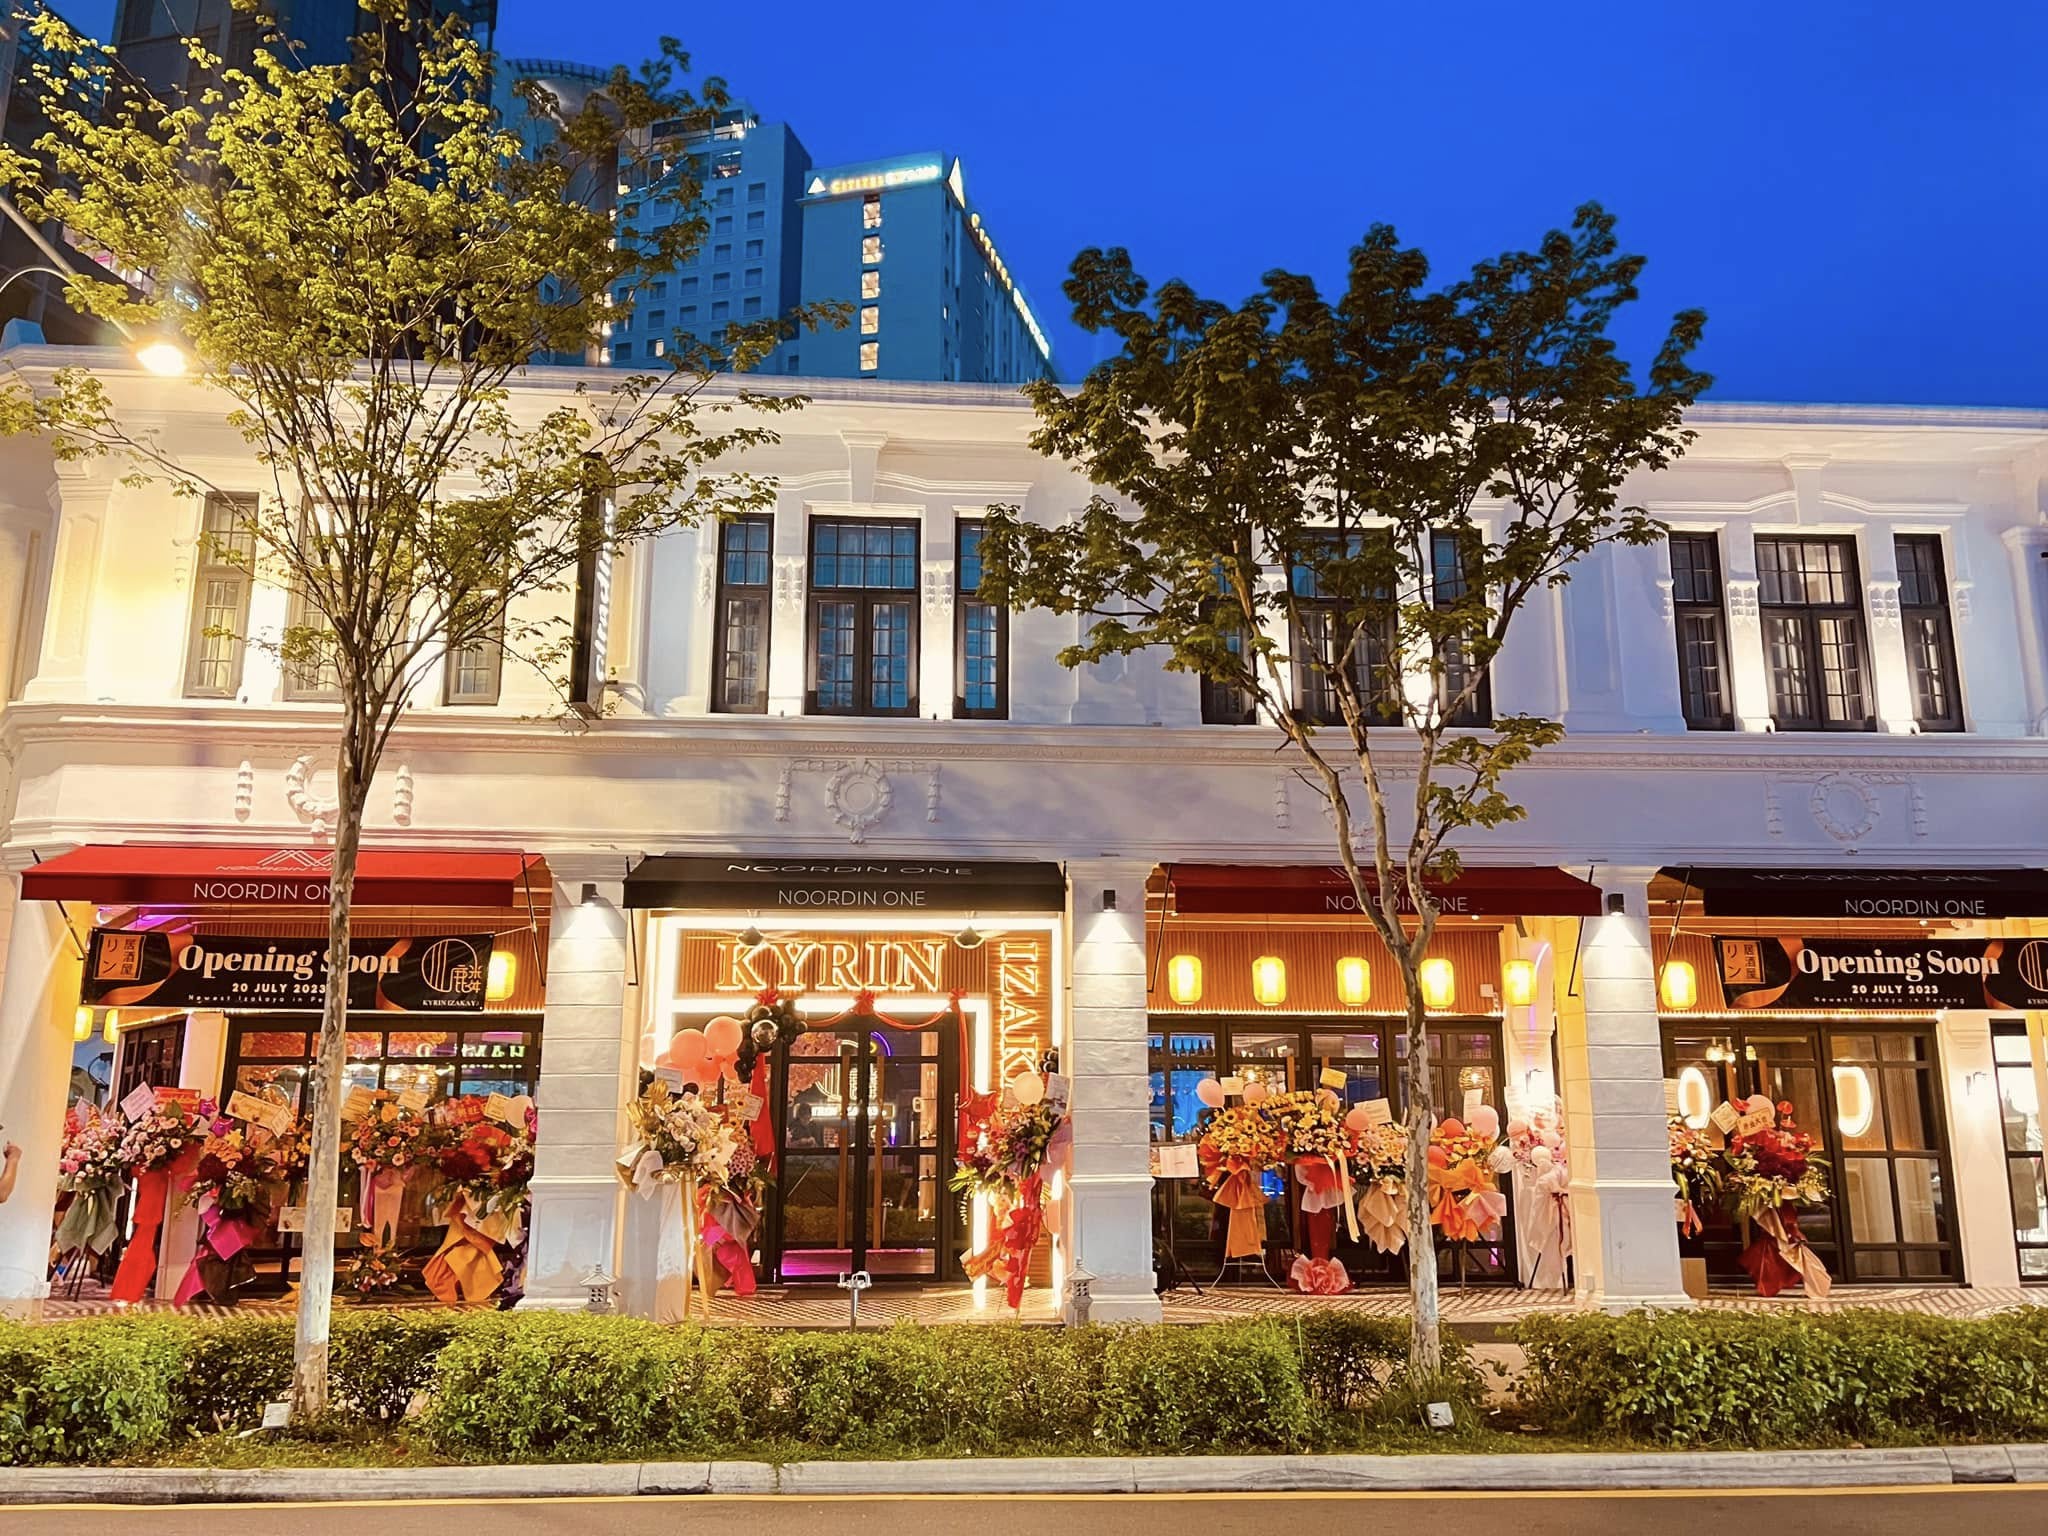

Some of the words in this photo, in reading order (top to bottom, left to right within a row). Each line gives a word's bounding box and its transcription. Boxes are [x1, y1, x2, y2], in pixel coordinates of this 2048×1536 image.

[727, 864, 888, 874] NOORDIN
[900, 867, 973, 875] ONE
[193, 882, 298, 900] NOORDIN
[304, 883, 331, 900] ON
[778, 889, 877, 906] NOORDIN
[883, 889, 926, 907] ONE
[1845, 899, 1939, 915] NOORDIN
[1944, 899, 1986, 916] ONE
[178, 944, 317, 980] Opening
[715, 939, 947, 993] KYRIN
[1796, 948, 1924, 982] Opening
[1926, 949, 2001, 975] Soon
[232, 982, 248, 993] 20
[254, 983, 288, 993] JULY
[293, 983, 326, 994] 2023
[1851, 984, 1868, 995] 20
[1872, 984, 1903, 995] JULY
[1908, 984, 1939, 995] 2023
[1000, 941, 1040, 1088] IZAK
